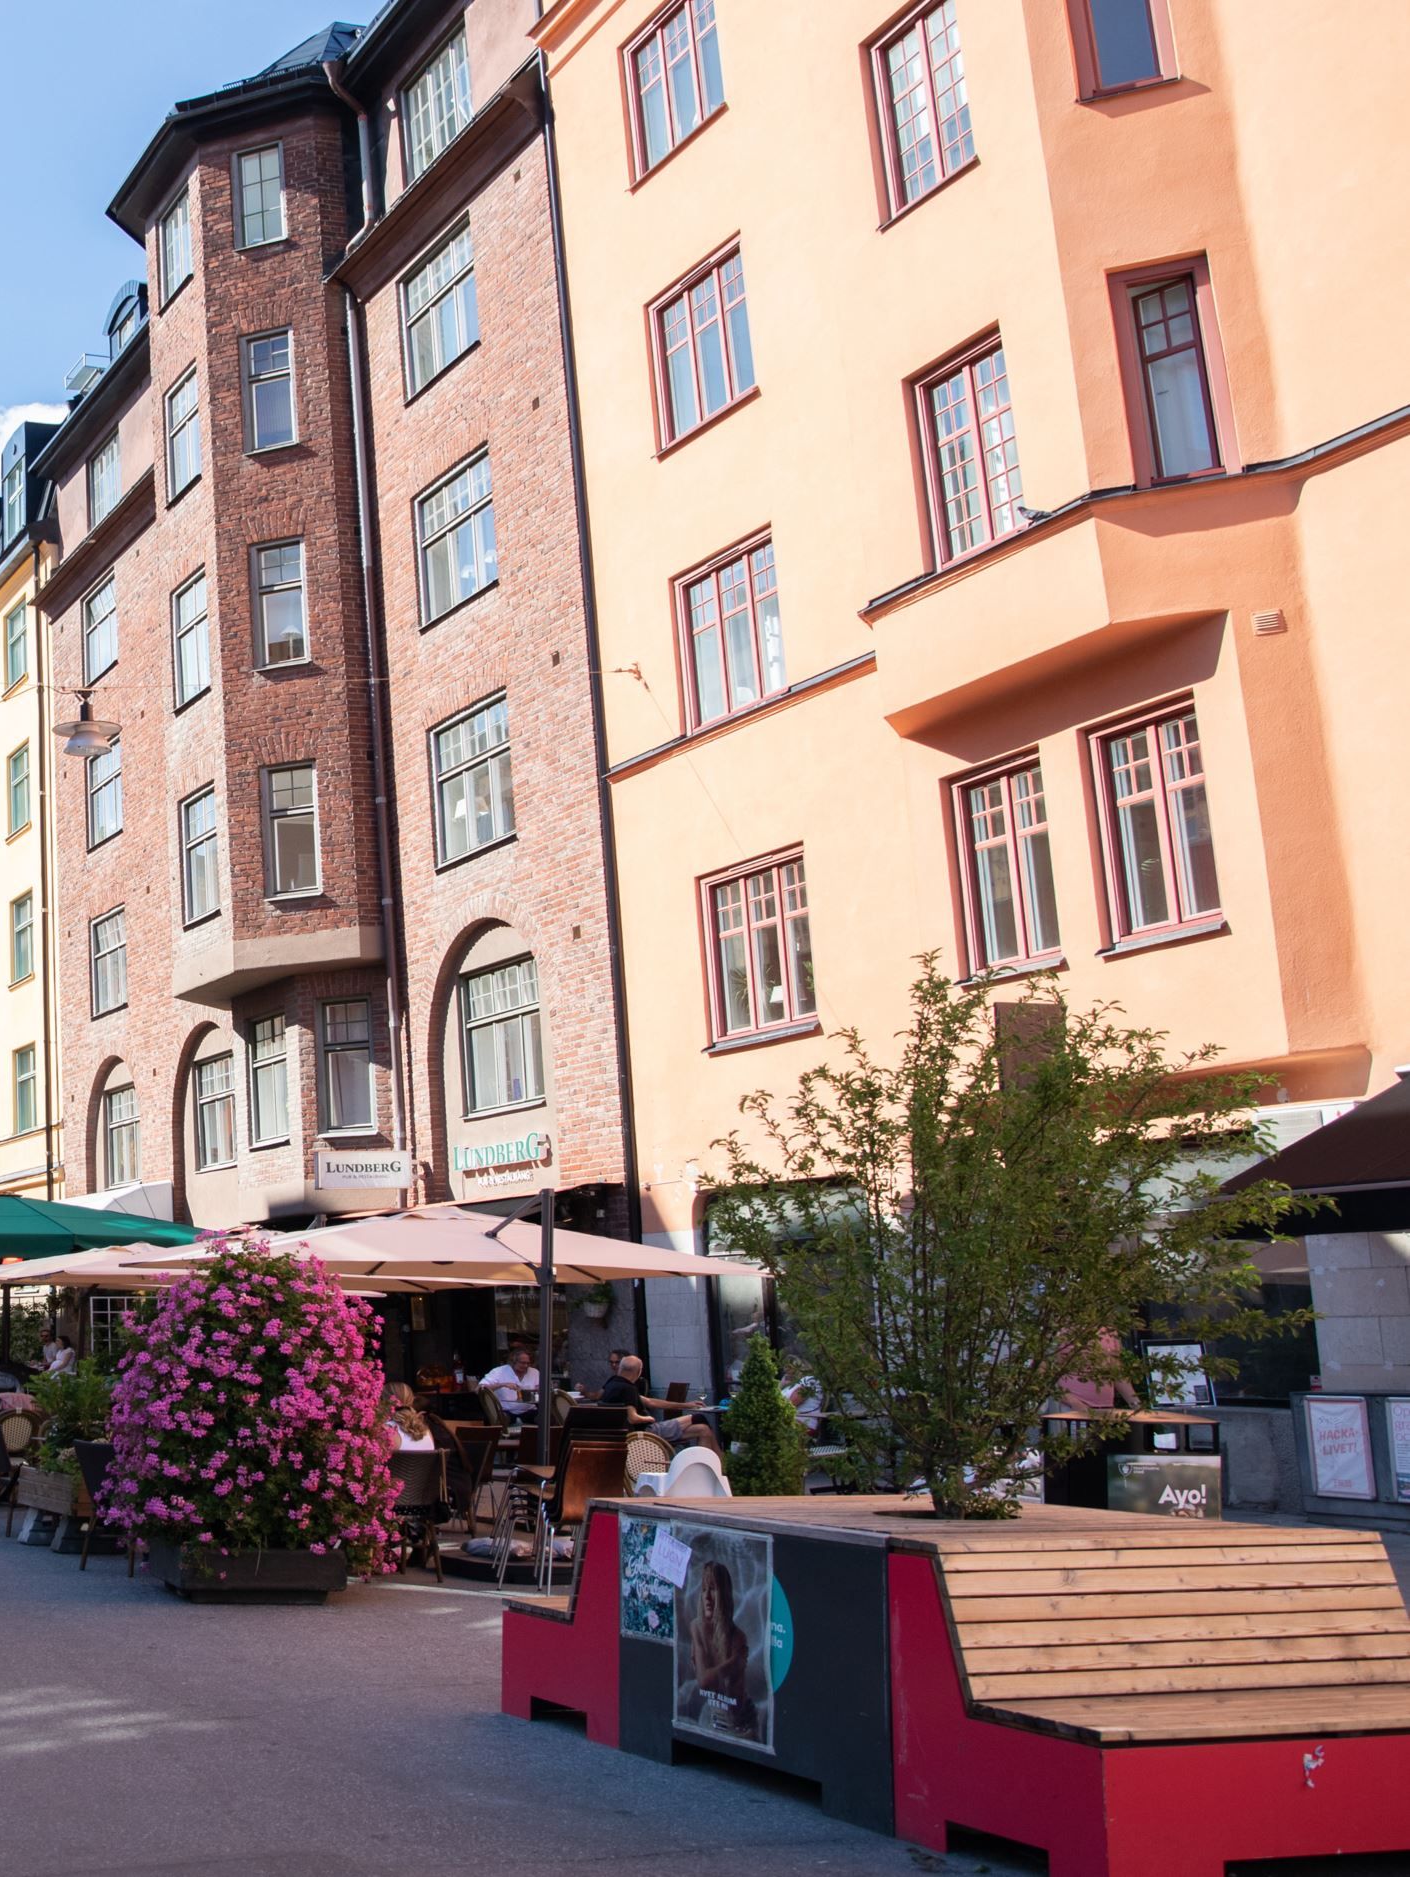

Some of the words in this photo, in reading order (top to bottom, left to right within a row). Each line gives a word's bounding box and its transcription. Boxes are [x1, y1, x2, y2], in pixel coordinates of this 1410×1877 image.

[453, 1132, 540, 1171] LUNDBERG
[326, 1160, 402, 1173] LUNDBERG
[1158, 1484, 1207, 1509] Ayo!
